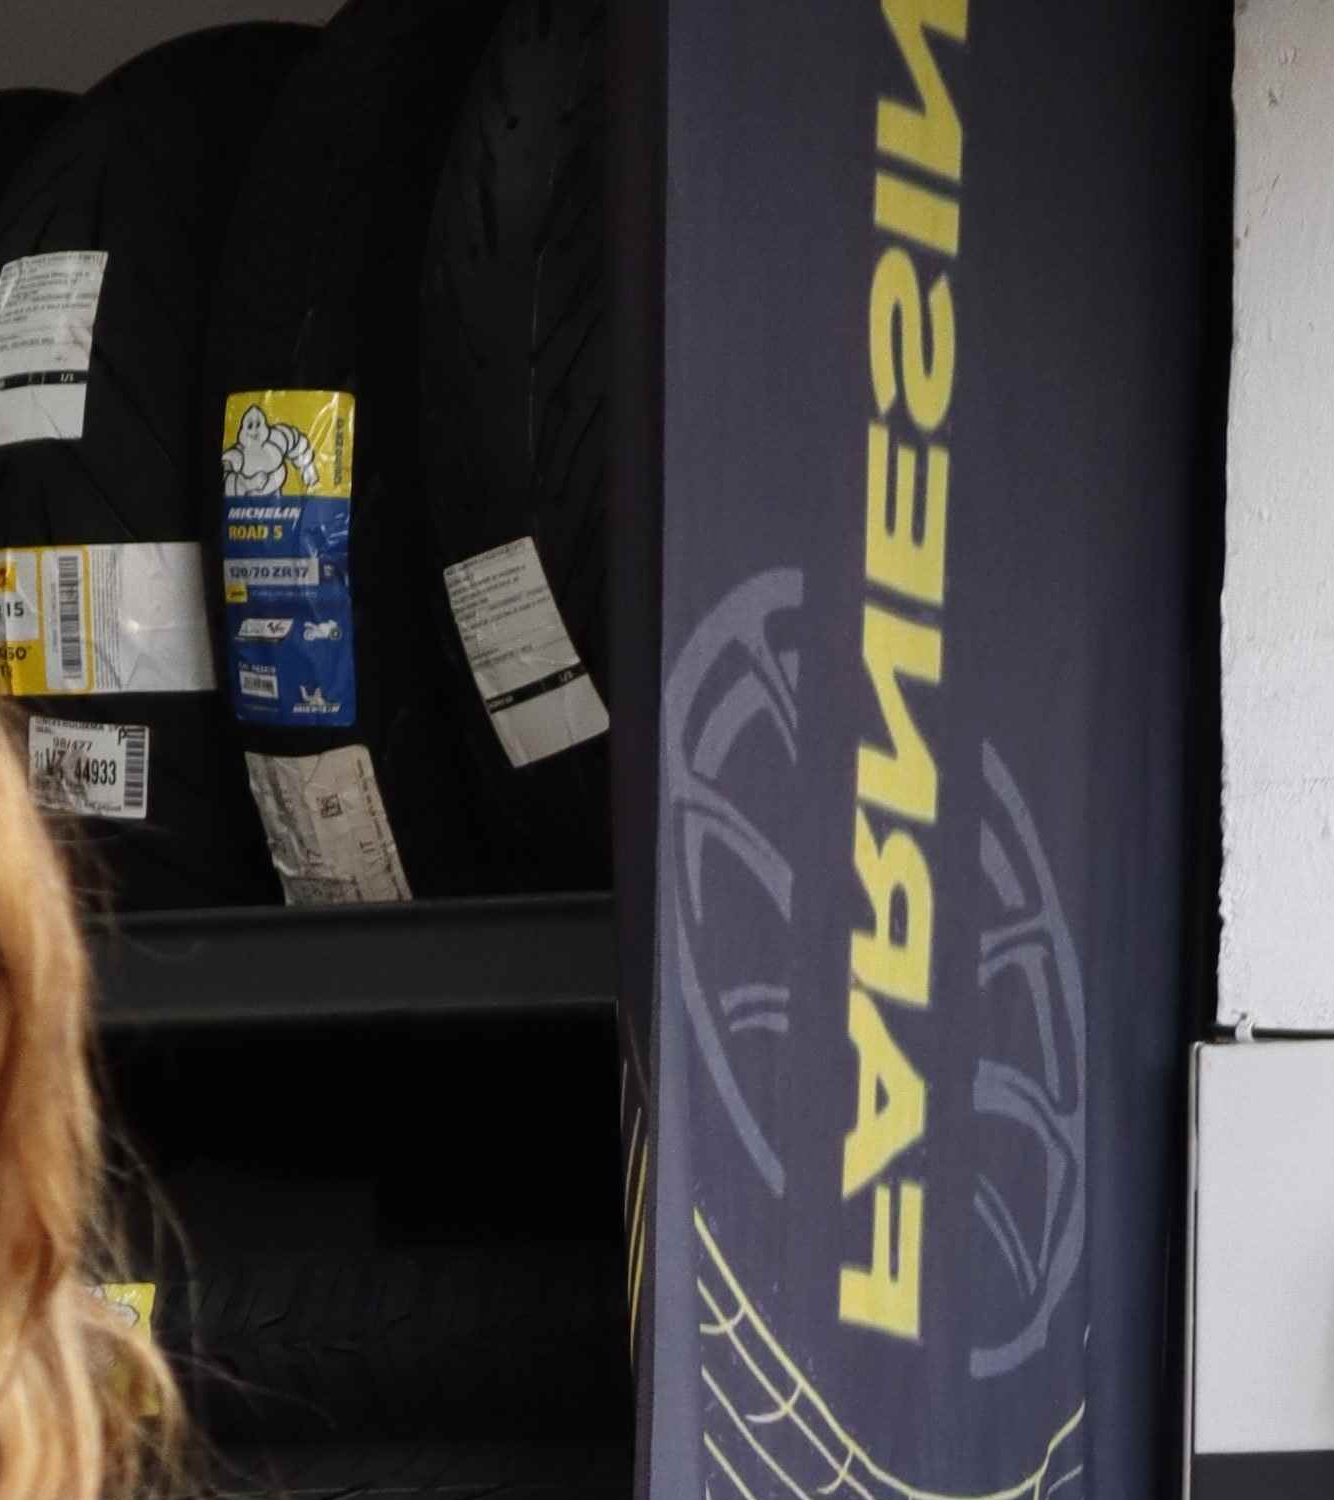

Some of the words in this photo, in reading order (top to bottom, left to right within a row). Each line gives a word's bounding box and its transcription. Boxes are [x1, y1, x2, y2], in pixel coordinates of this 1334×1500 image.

[228, 506, 301, 523] MICHELIN
[229, 525, 268, 540] ROAD
[273, 525, 283, 540] 5
